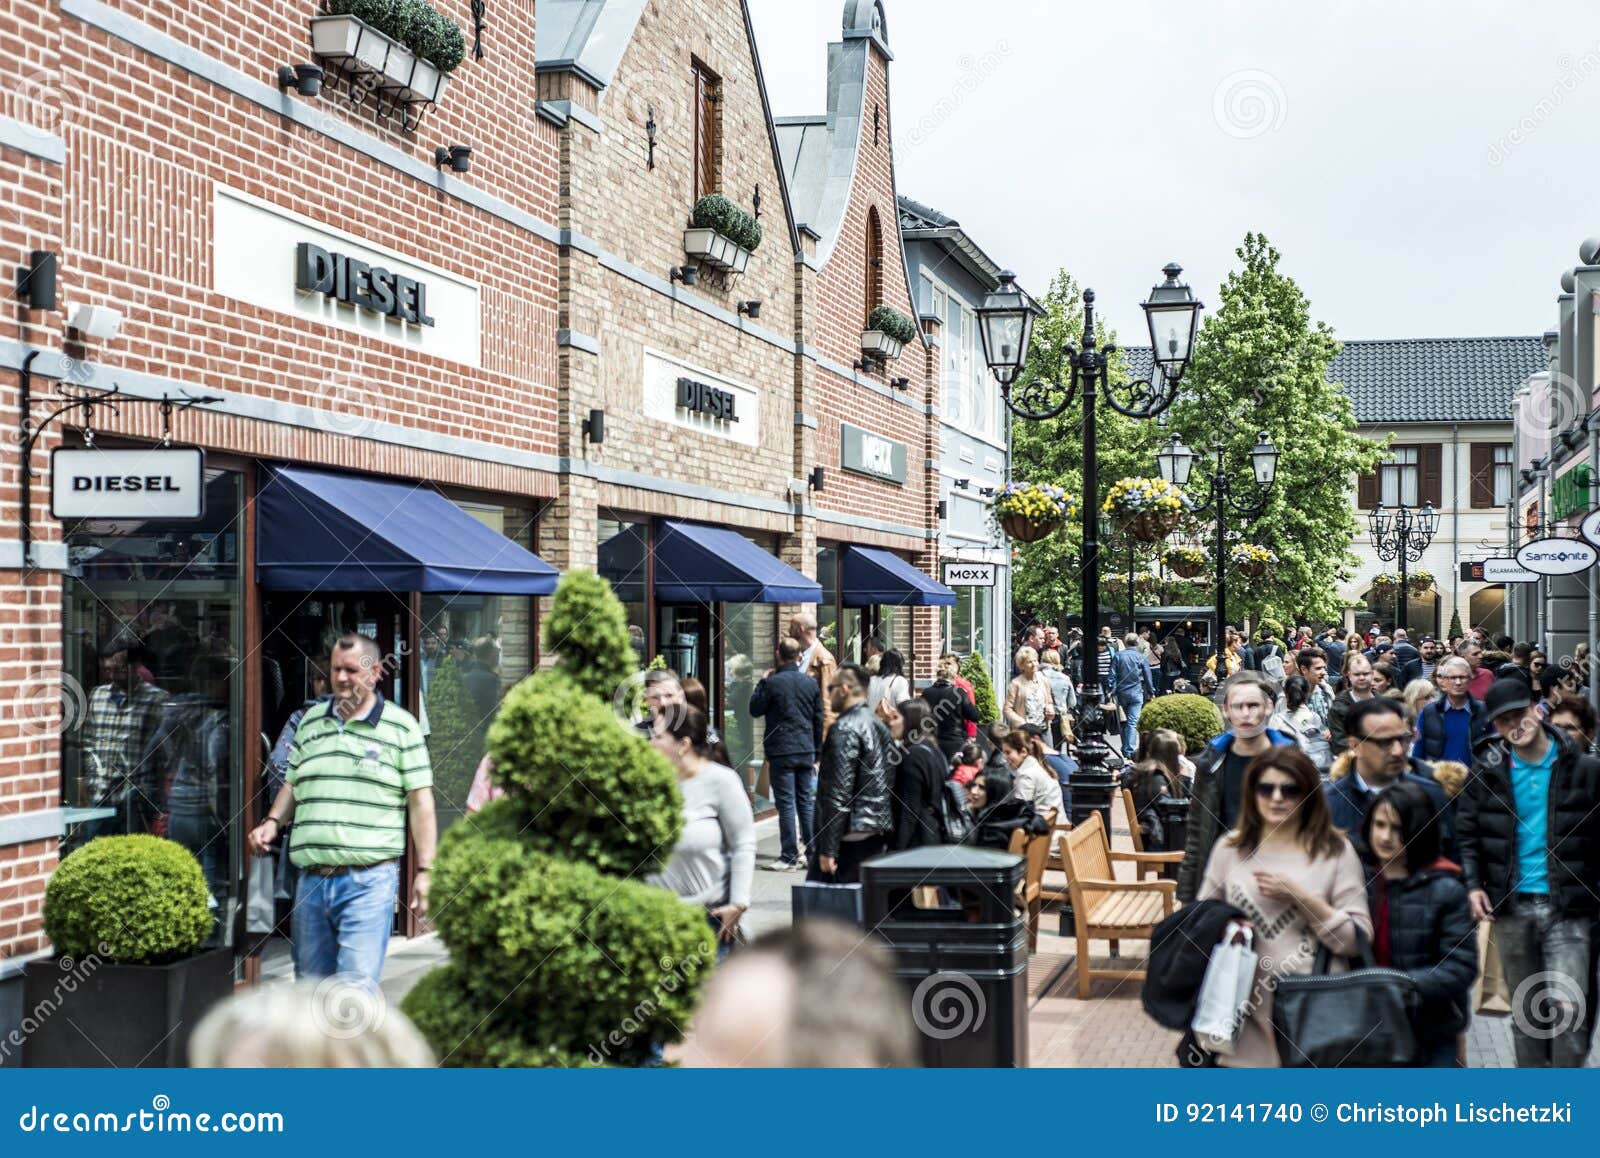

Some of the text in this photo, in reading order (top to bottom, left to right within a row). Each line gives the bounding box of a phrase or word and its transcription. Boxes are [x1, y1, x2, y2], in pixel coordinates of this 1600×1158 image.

[297, 242, 435, 327] DIESEL
[676, 377, 739, 423] DIESEL
[72, 476, 181, 492] DIESEL
[1525, 552, 1588, 561] Samsonite
